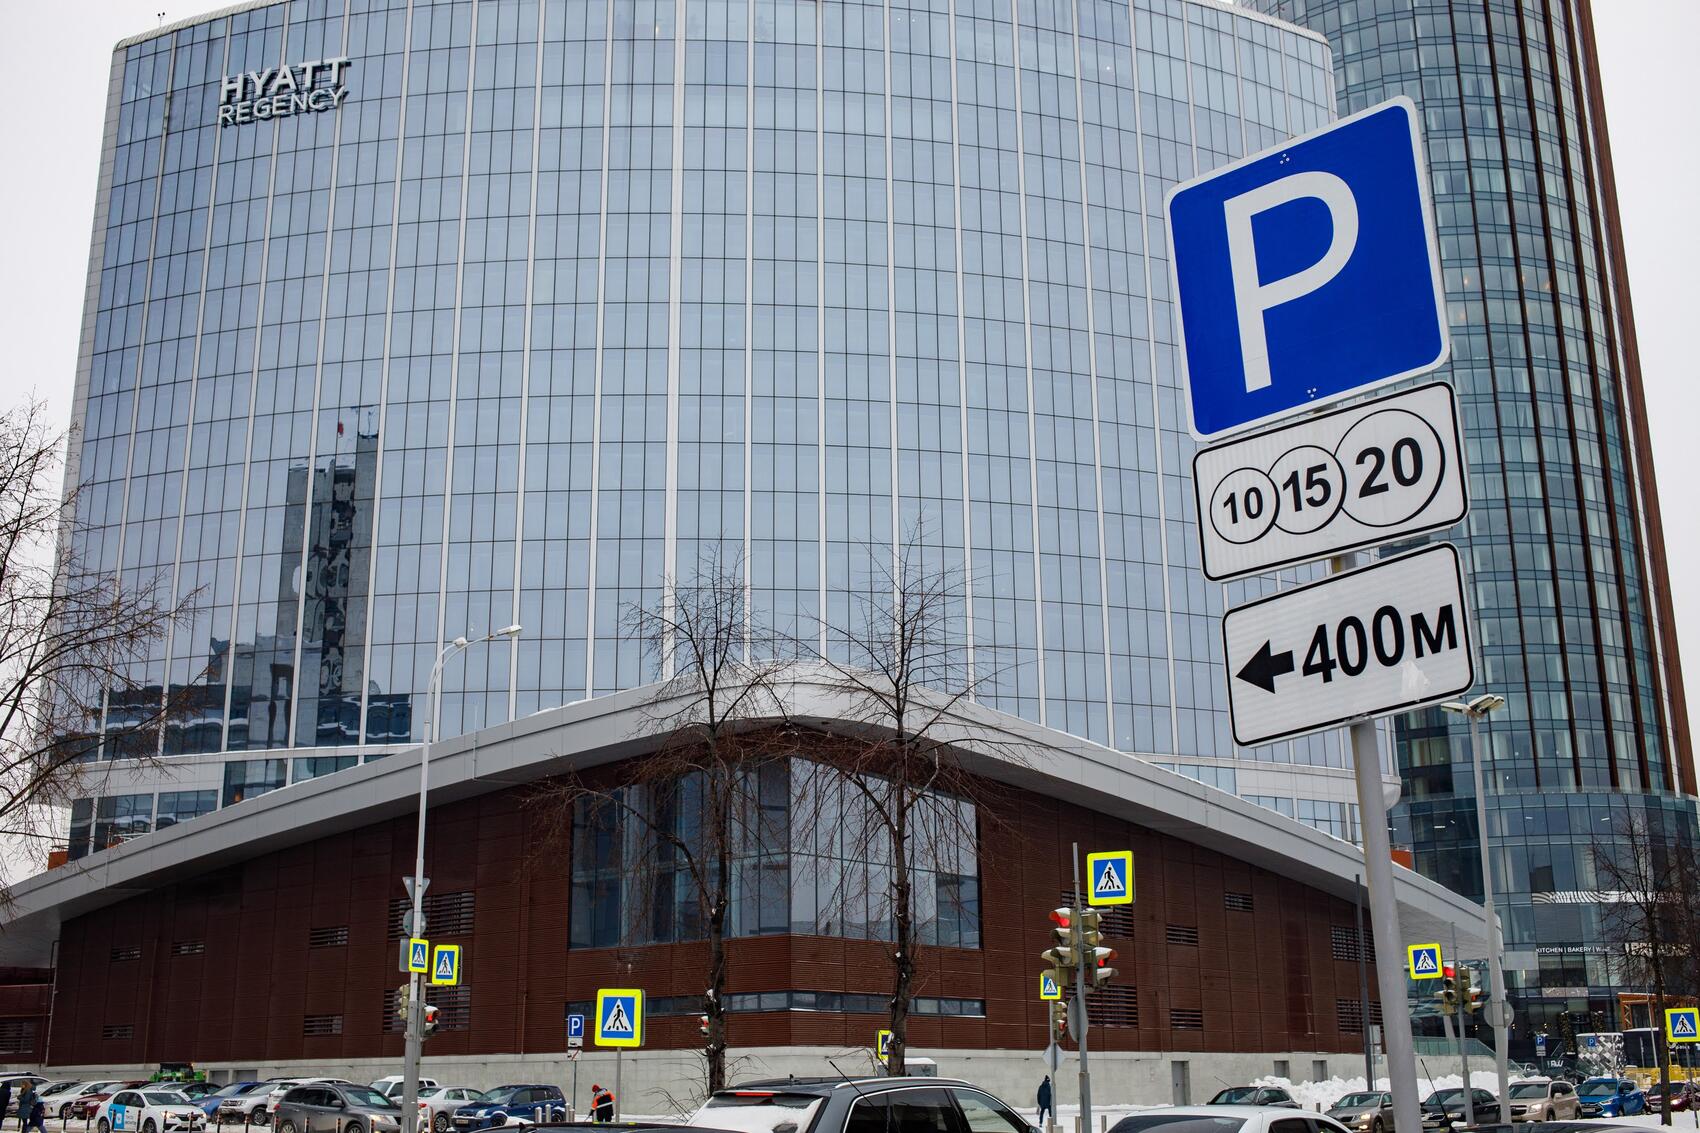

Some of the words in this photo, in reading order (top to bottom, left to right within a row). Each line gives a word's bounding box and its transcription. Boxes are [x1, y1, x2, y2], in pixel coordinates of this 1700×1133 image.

[220, 56, 348, 104] HYATT
[218, 86, 345, 124] REGENCY
[1223, 171, 1359, 393] P
[1223, 486, 1264, 525] 10
[1282, 463, 1332, 513] 15
[1355, 437, 1423, 499] 20
[1536, 946, 1563, 954] KITCHEN
[571, 1017, 581, 1036] P
